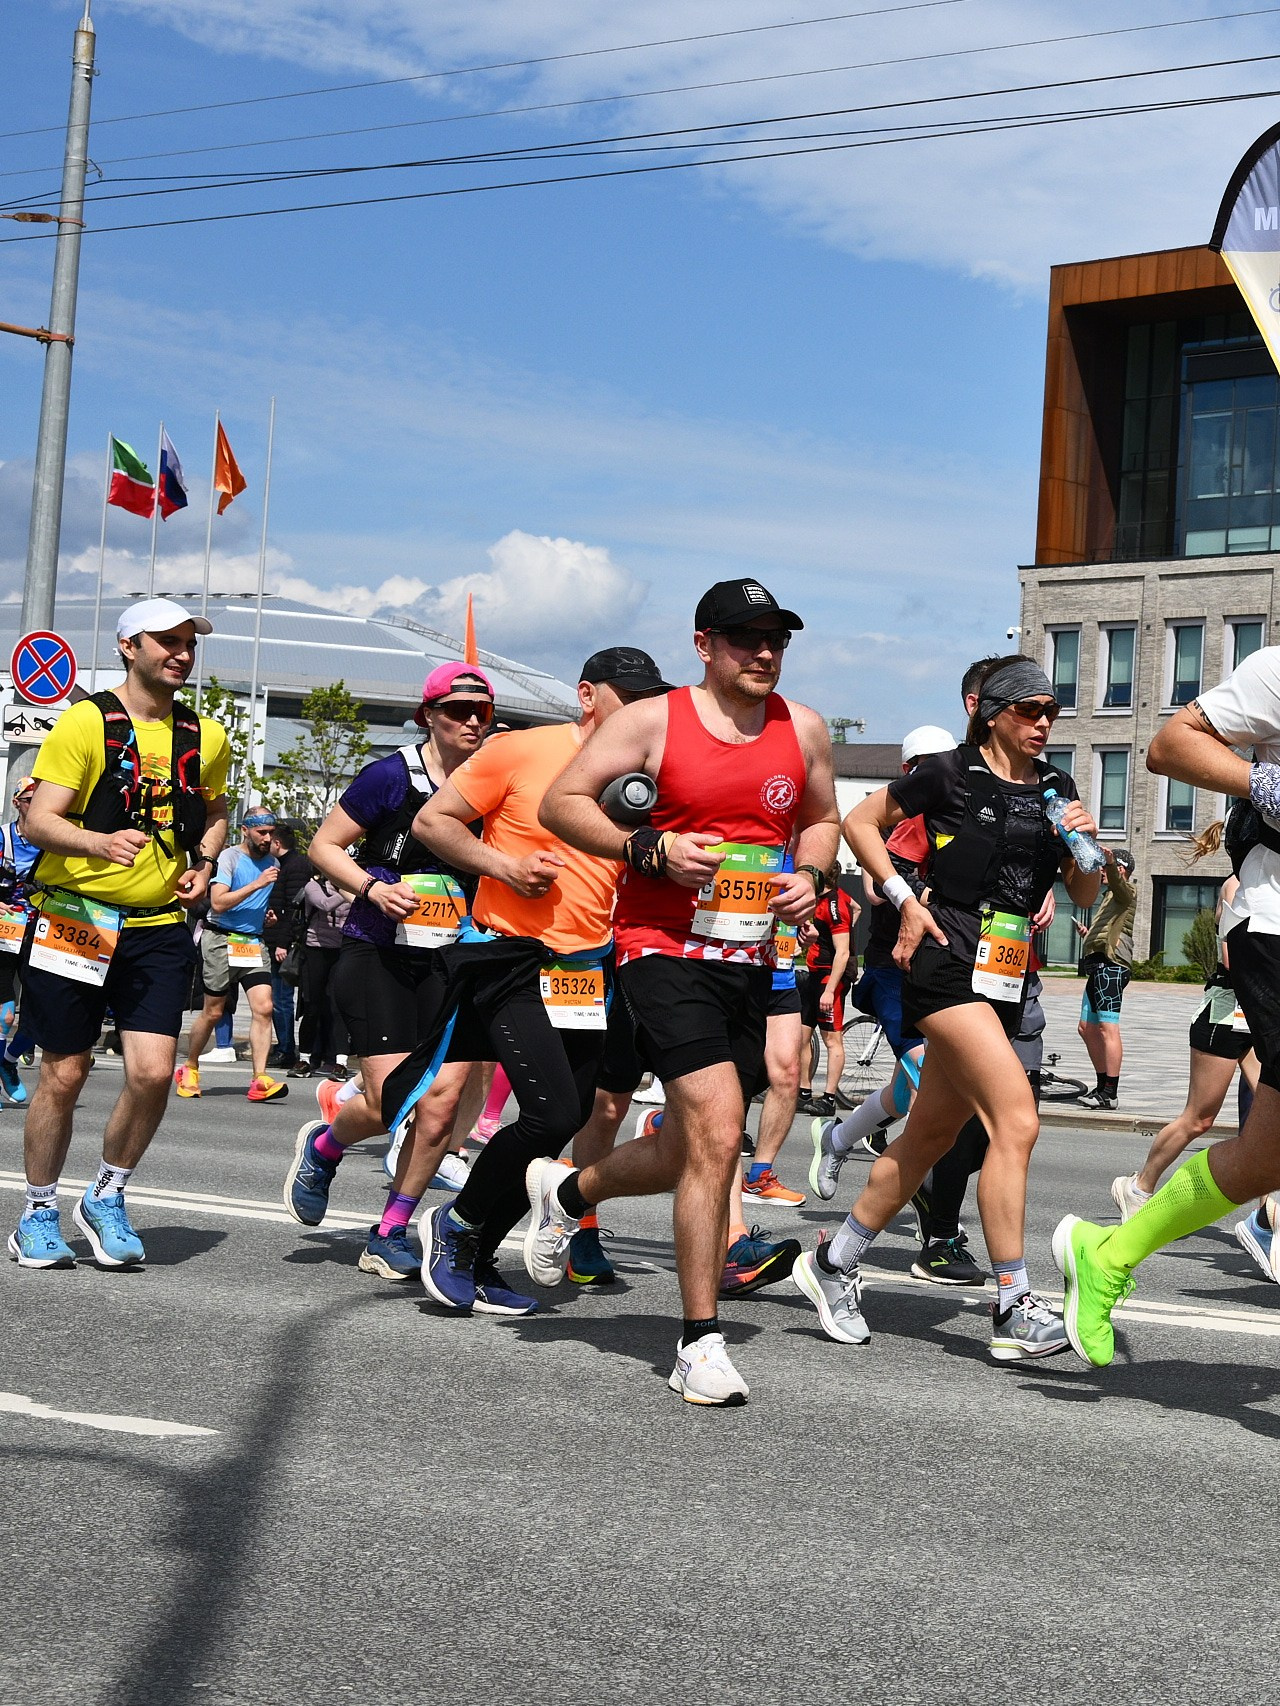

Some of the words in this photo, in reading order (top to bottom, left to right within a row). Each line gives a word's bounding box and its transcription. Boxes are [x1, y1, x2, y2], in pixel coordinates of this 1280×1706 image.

[719, 879, 773, 901] 35519
[421, 901, 456, 918] 2717
[39, 923, 47, 933] C
[53, 923, 101, 950] 3384
[980, 947, 987, 958] E
[995, 945, 1025, 967] 3862
[542, 982, 549, 992] E
[552, 977, 596, 995] 35326
